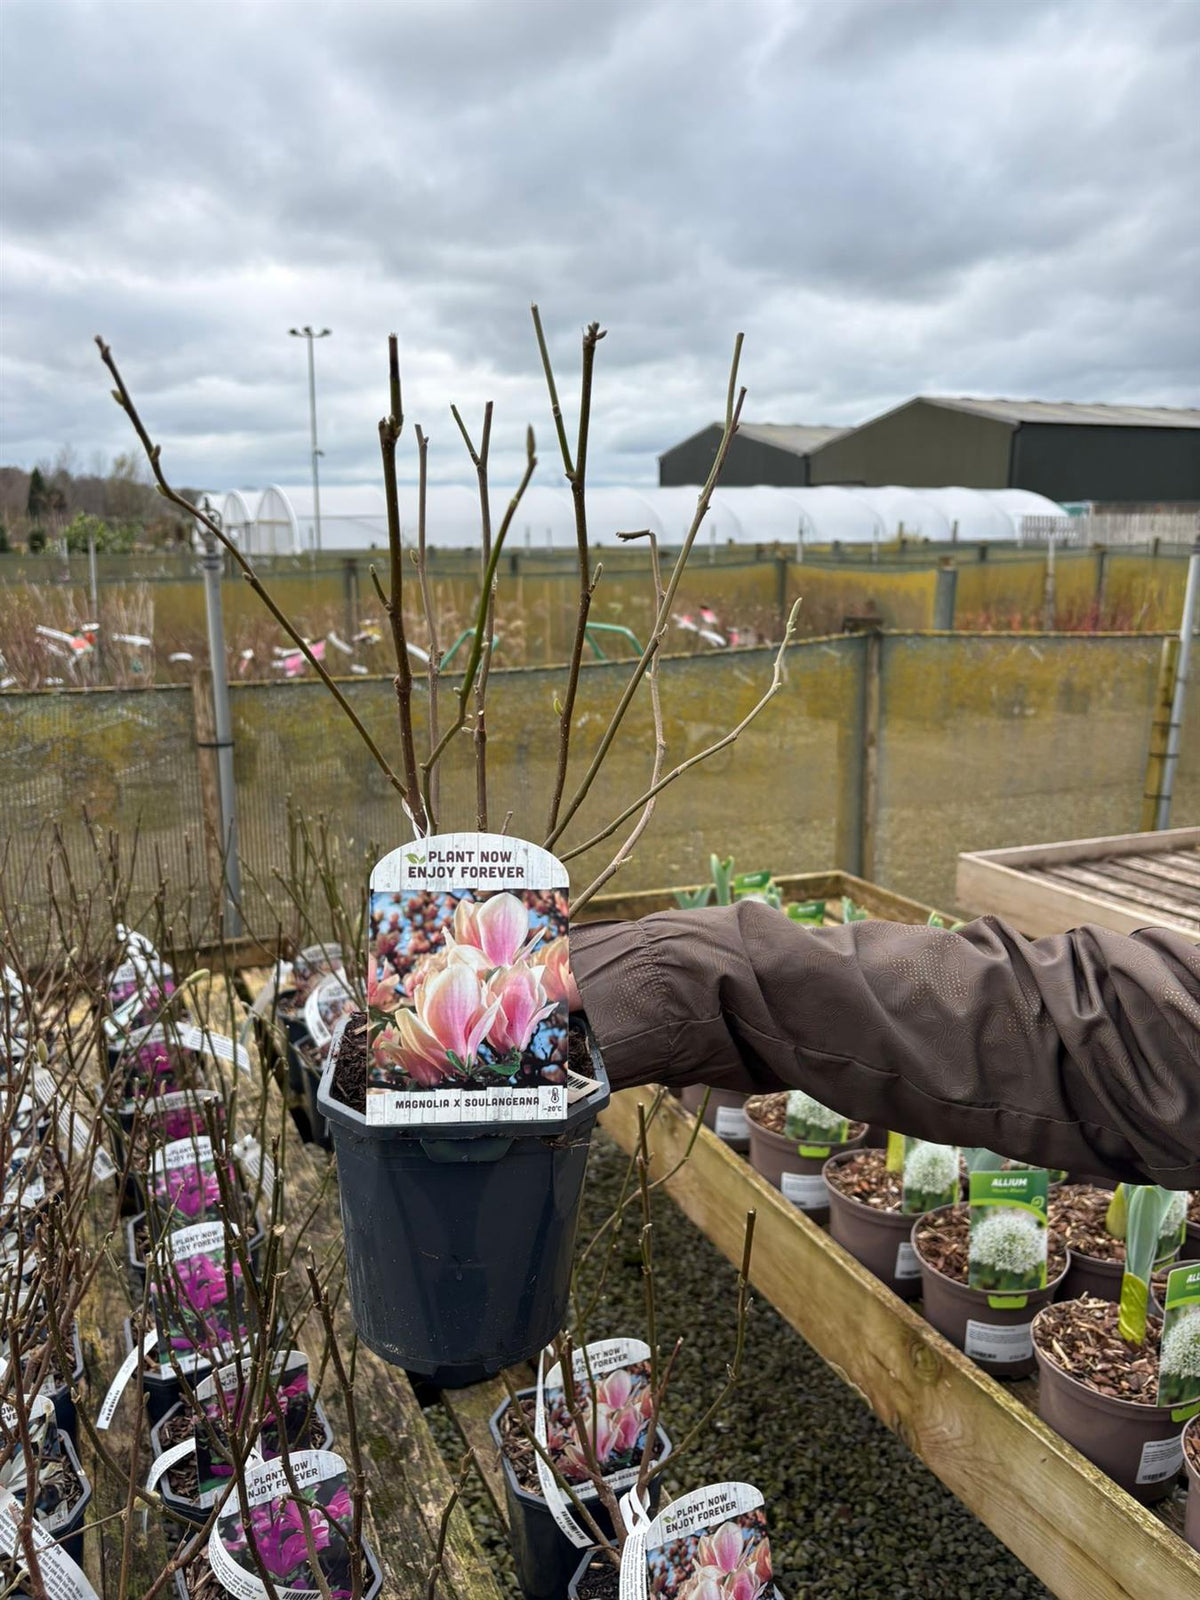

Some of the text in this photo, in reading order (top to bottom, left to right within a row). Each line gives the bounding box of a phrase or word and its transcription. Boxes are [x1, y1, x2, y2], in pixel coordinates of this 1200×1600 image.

[428, 851, 512, 863] PLANT NOW
[408, 867, 525, 879] ENJOY FOREVER
[395, 1099, 450, 1110] MAGNOLIA
[464, 1096, 540, 1108] SOULANGEANA
[990, 1178, 1028, 1187] ALLIUM
[193, 1236, 224, 1249] FOREVE
[576, 1346, 621, 1365] PLNT NOW
[593, 1353, 628, 1369] FOREVER
[253, 1460, 309, 1487] PLANT OW
[248, 1467, 319, 1499] NJOY FOEVER
[677, 1492, 728, 1519] PLANT NOW
[666, 1500, 738, 1534] ENJOY FOREVER
